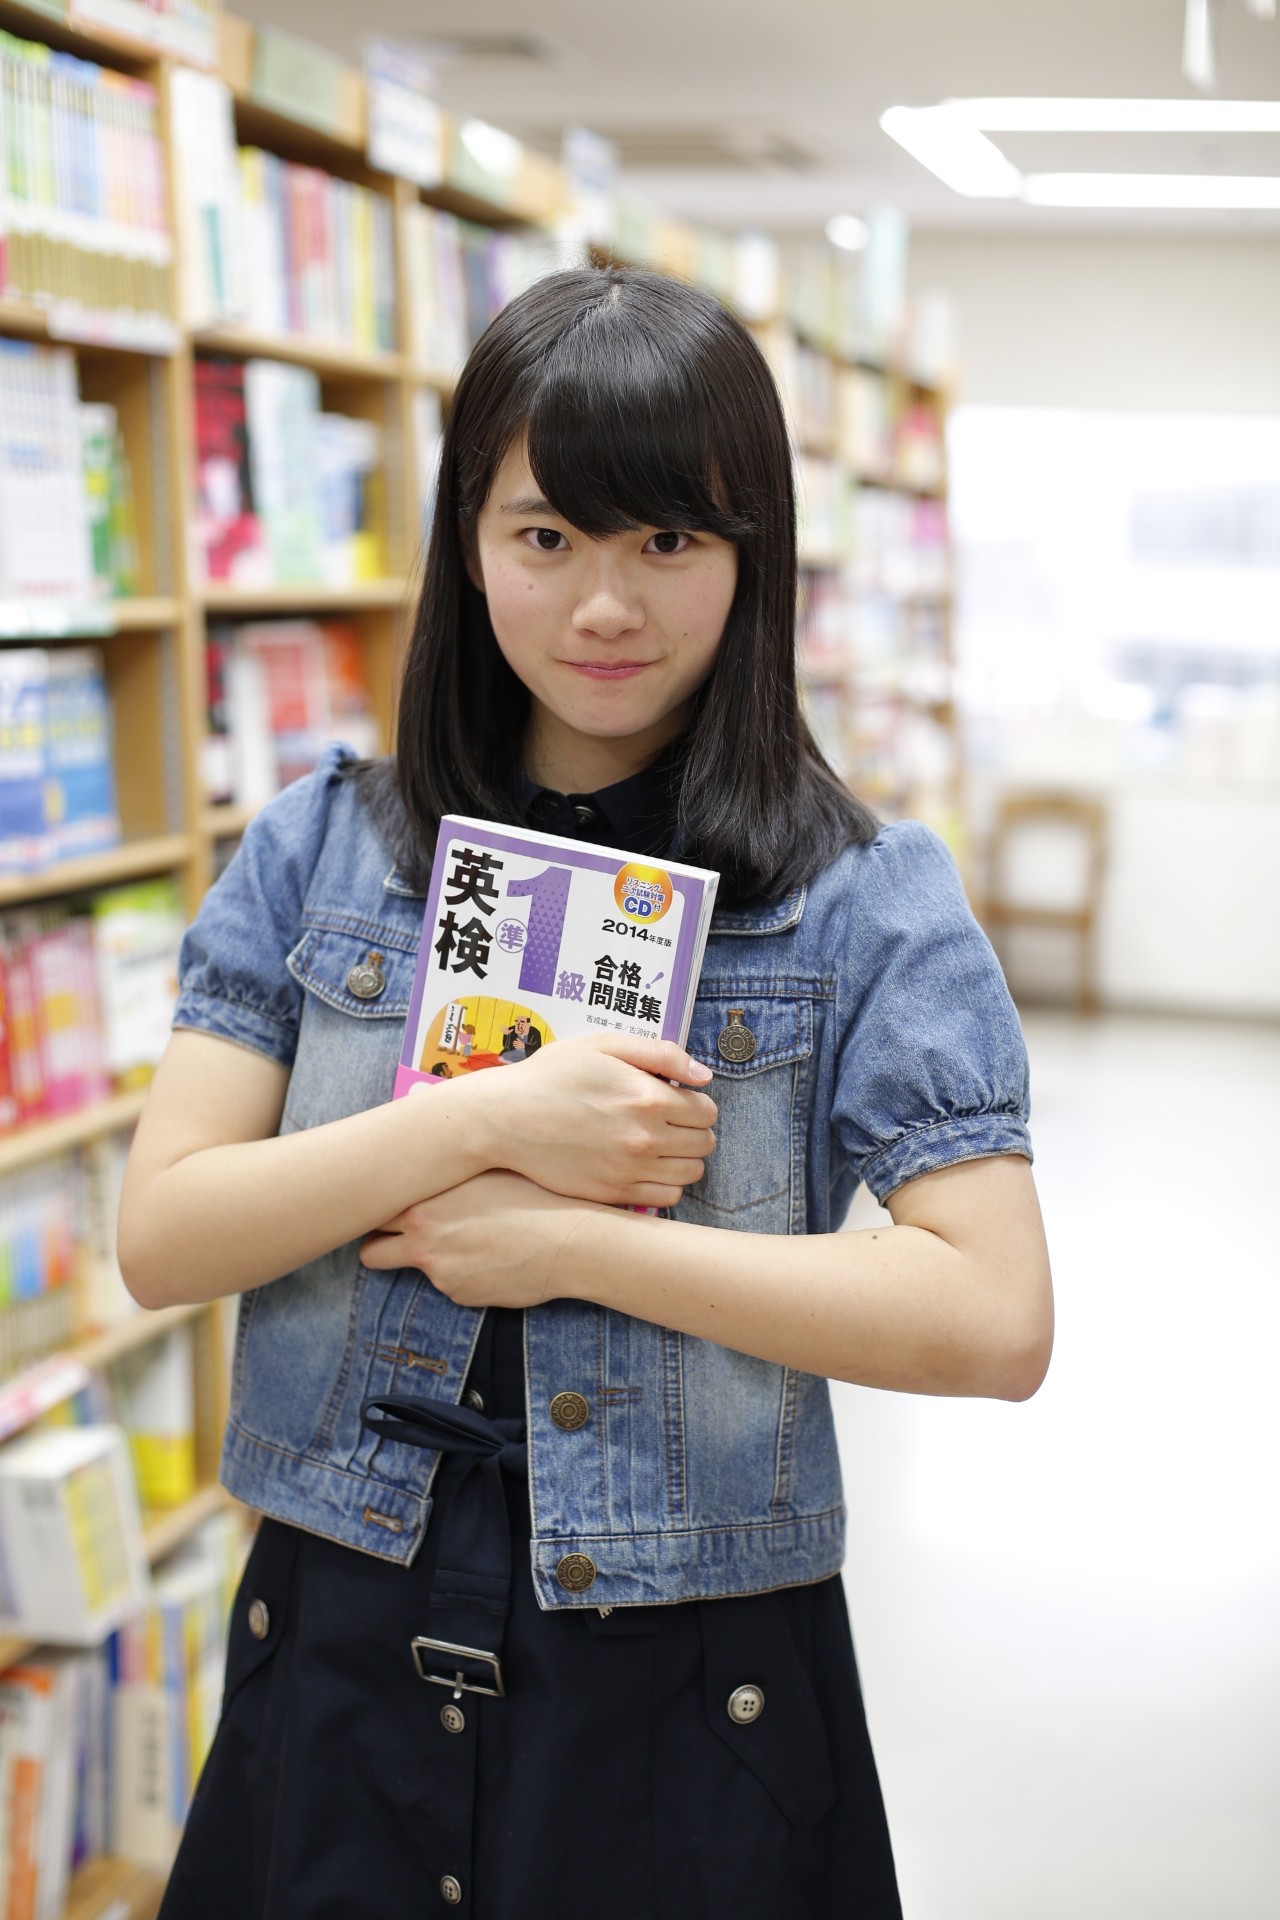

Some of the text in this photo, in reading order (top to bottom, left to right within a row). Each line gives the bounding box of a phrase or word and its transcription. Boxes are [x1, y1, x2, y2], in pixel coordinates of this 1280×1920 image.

[435, 848, 504, 980] 英検
[588, 981, 662, 1024] 問題集
